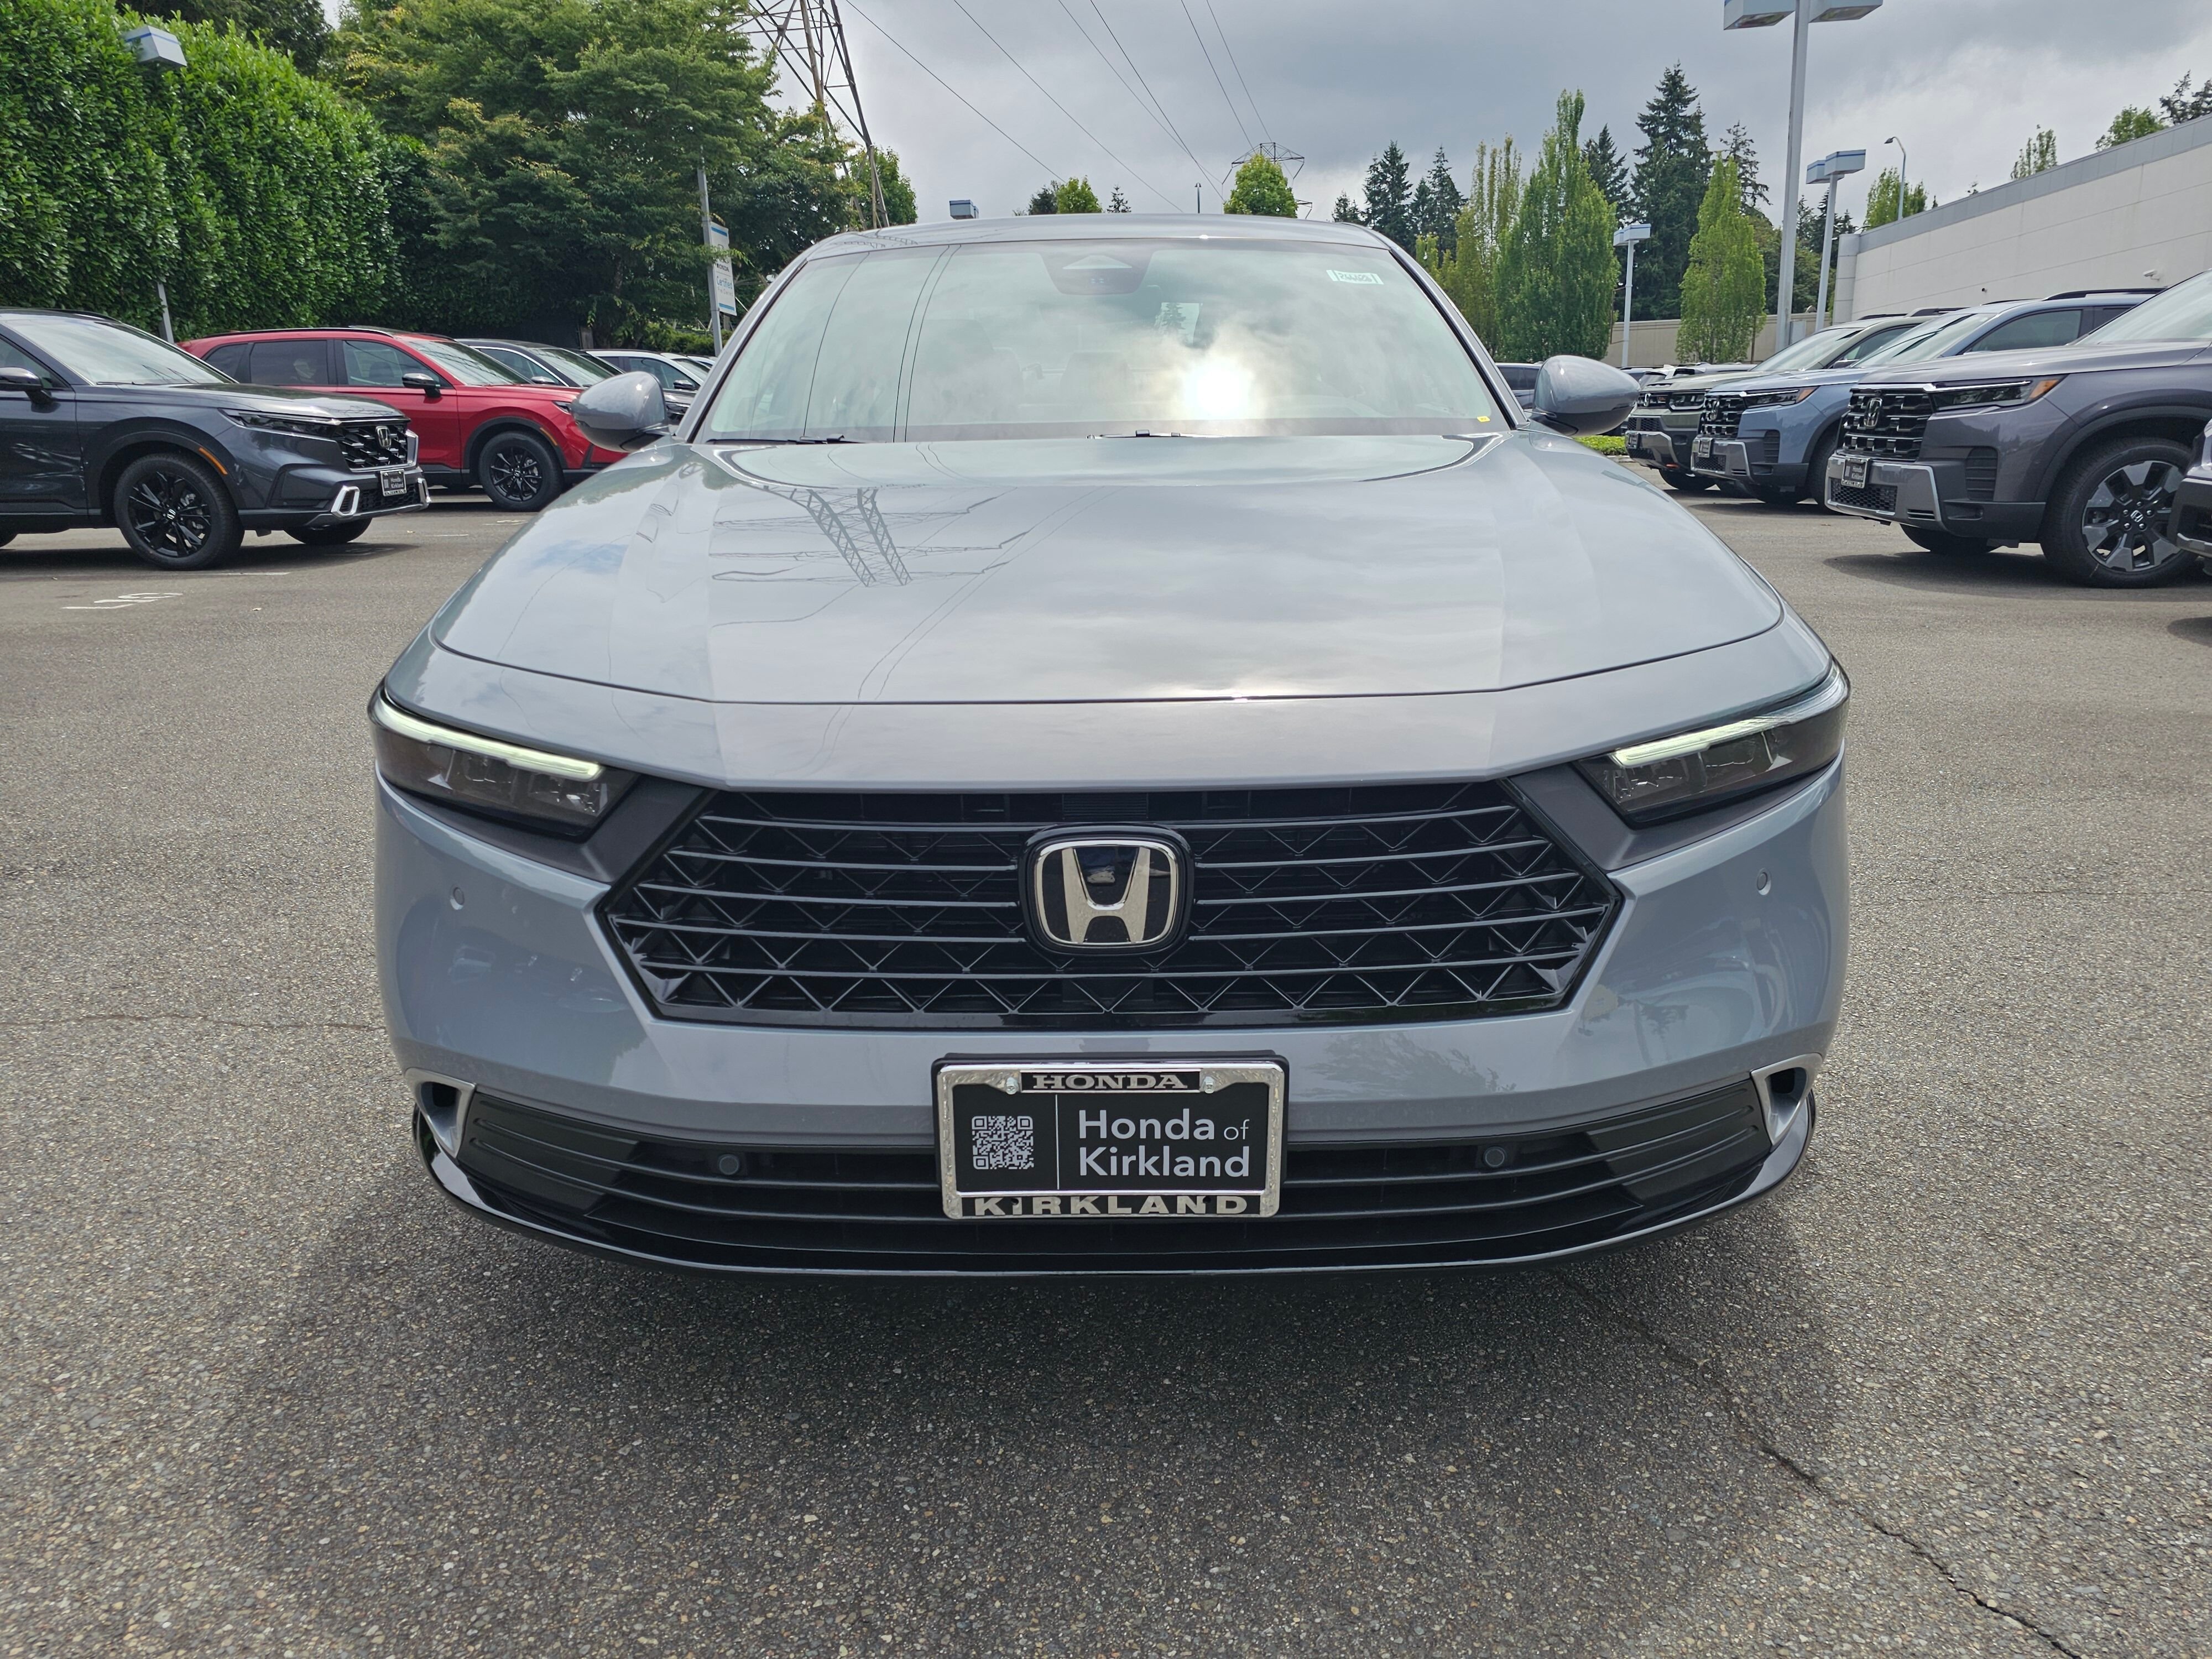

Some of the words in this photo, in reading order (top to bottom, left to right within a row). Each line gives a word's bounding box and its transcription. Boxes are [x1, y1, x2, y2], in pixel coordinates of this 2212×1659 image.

[1032, 1074, 1188, 1090] HONDA
[1079, 1108, 1214, 1140] Honda
[1223, 1119, 1250, 1140] of
[1079, 1145, 1250, 1177] Kirkland
[974, 1196, 1248, 1215] KIRKLAND
